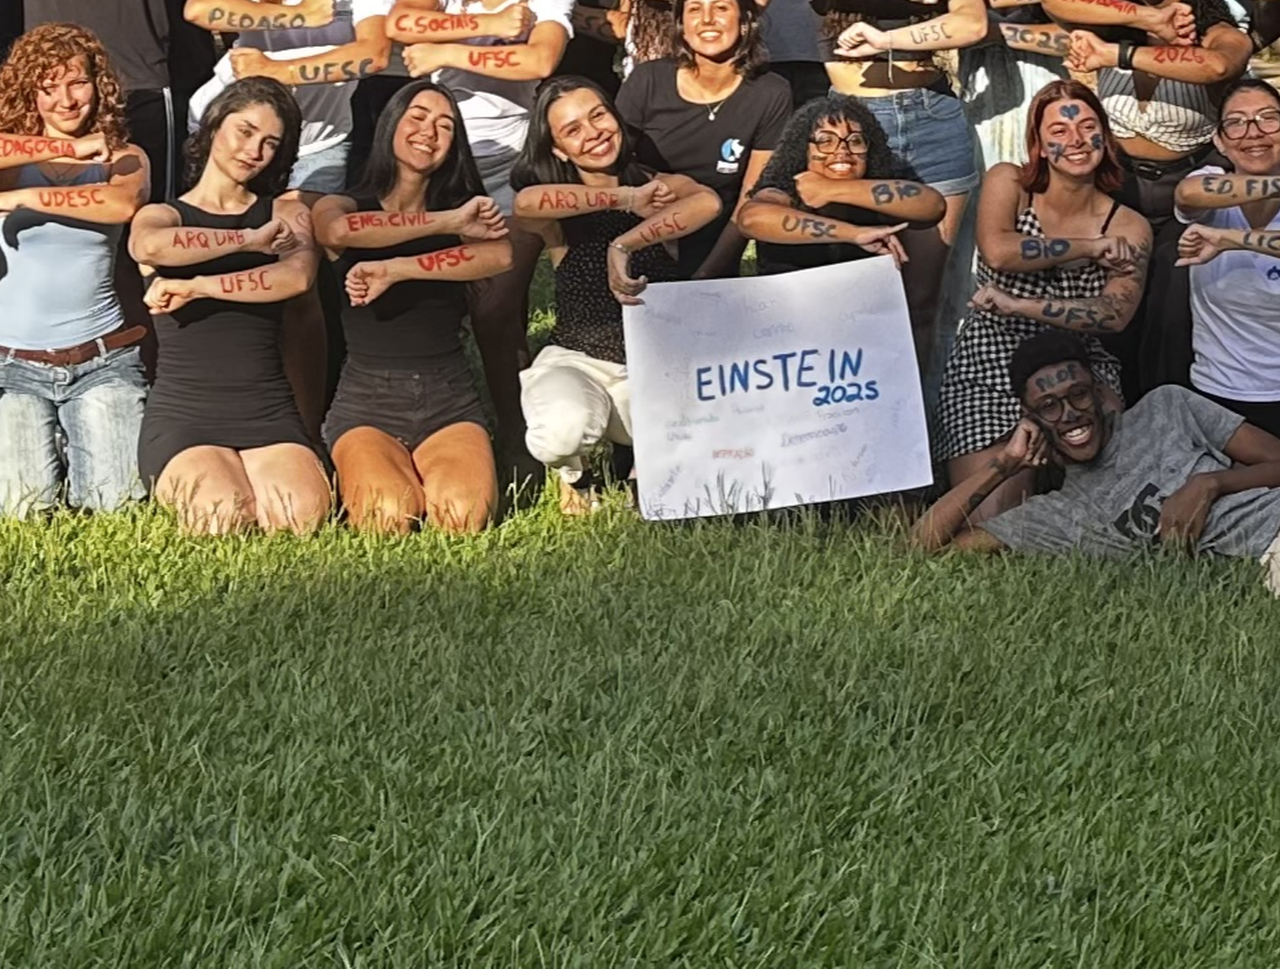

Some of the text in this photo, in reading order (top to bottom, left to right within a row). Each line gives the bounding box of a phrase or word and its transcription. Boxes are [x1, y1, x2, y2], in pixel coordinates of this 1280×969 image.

[207, 7, 306, 29] PEDAGO
[909, 22, 953, 45] UFSC
[298, 58, 375, 81] UFSC
[468, 49, 522, 68] UFSC
[39, 188, 106, 208] UDESC
[538, 191, 580, 211] ARQ
[639, 212, 687, 244] UFSC
[782, 215, 839, 238] UFSC
[172, 233, 209, 250] ARQ
[417, 246, 476, 272] UFSC
[220, 270, 273, 294] UFSC
[1042, 302, 1116, 330] UFSC
[696, 347, 863, 402] EINSTEIN
[812, 380, 879, 407] 2025
